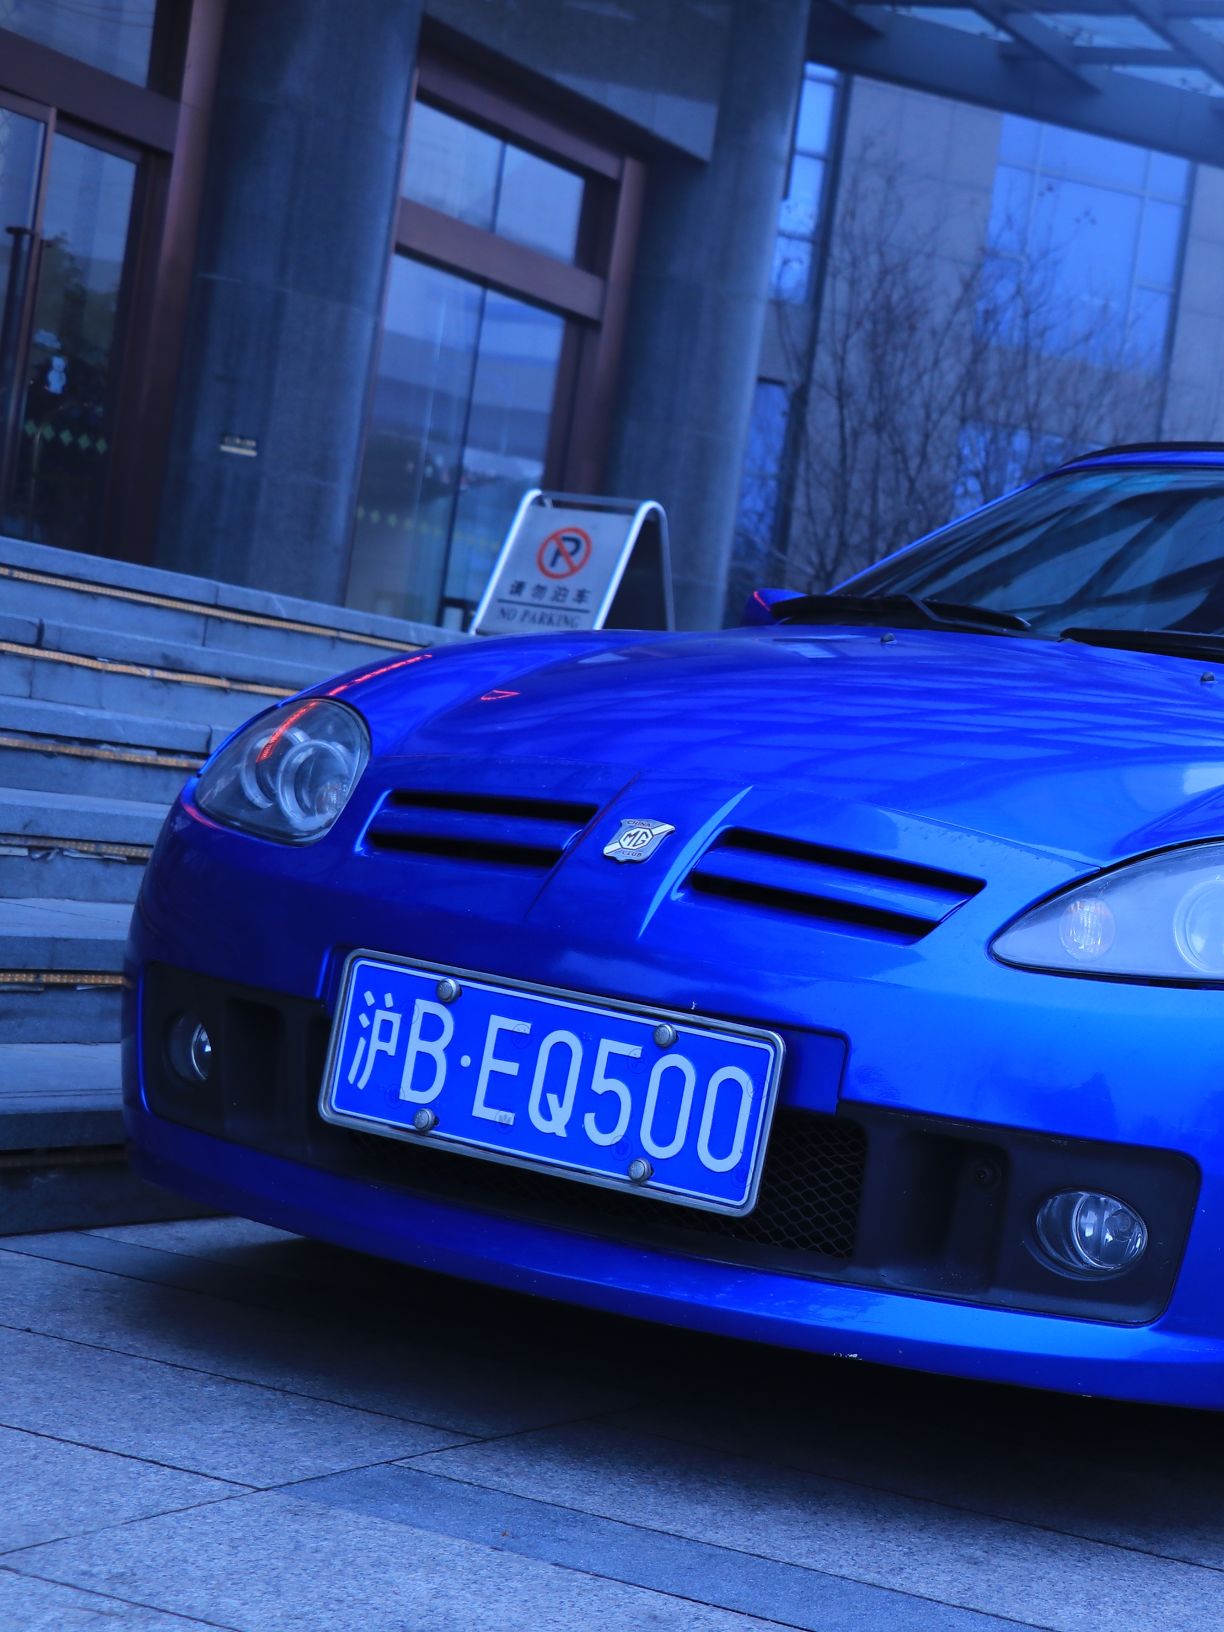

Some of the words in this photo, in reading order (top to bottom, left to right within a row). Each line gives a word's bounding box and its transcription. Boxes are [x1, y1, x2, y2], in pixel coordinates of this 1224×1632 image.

[498, 607, 518, 621] NO
[520, 609, 581, 629] PARKING
[627, 820, 651, 828] CHINA
[623, 831, 649, 847] MG
